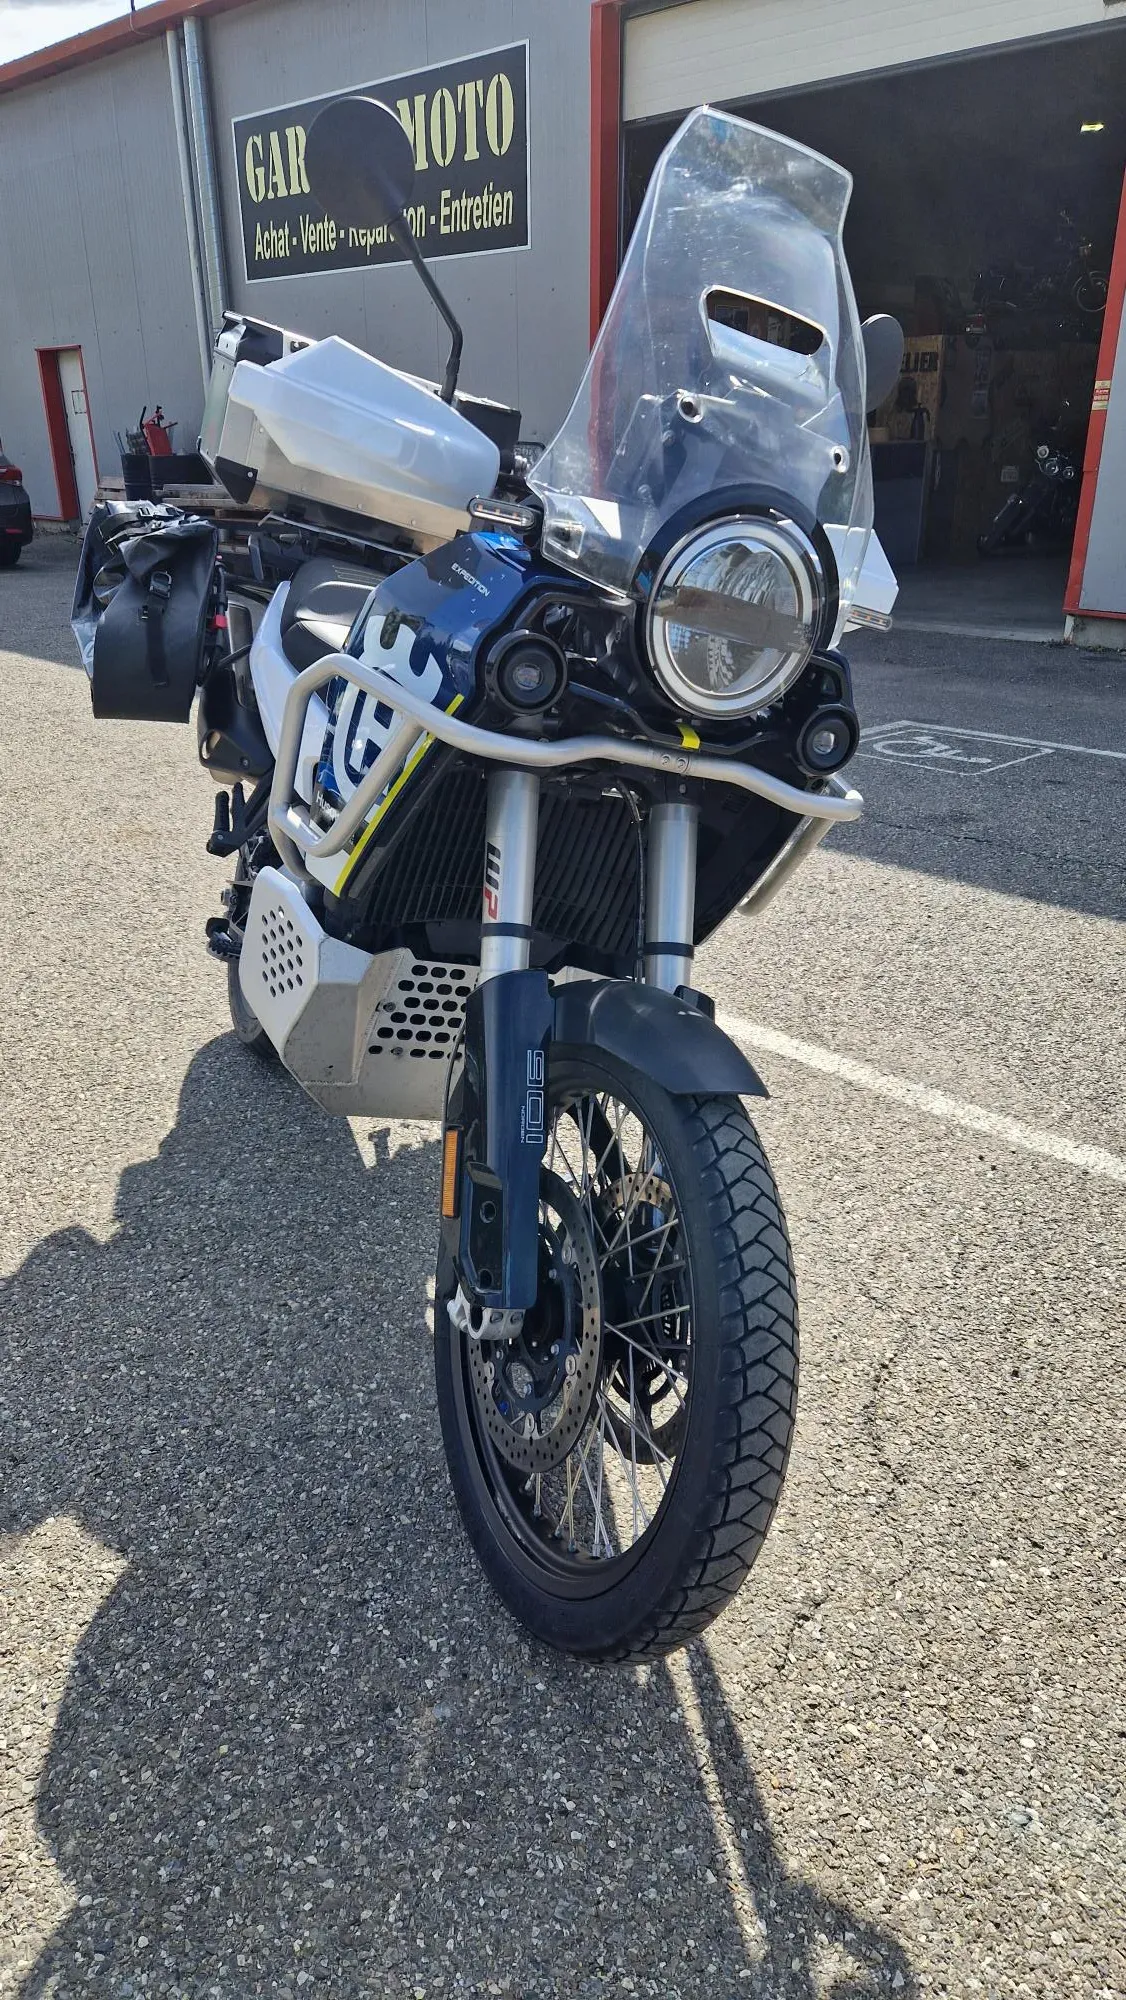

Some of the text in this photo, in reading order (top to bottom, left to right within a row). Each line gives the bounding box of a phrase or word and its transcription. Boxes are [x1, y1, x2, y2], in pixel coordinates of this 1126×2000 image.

[245, 73, 515, 203] GAR MOTO
[255, 220, 290, 260] Achat
[300, 213, 337, 254] Vente
[440, 182, 514, 234] Entretien
[900, 351, 938, 372] LIER
[451, 562, 490, 597] EXPEDITION
[526, 1049, 544, 1144] 901
